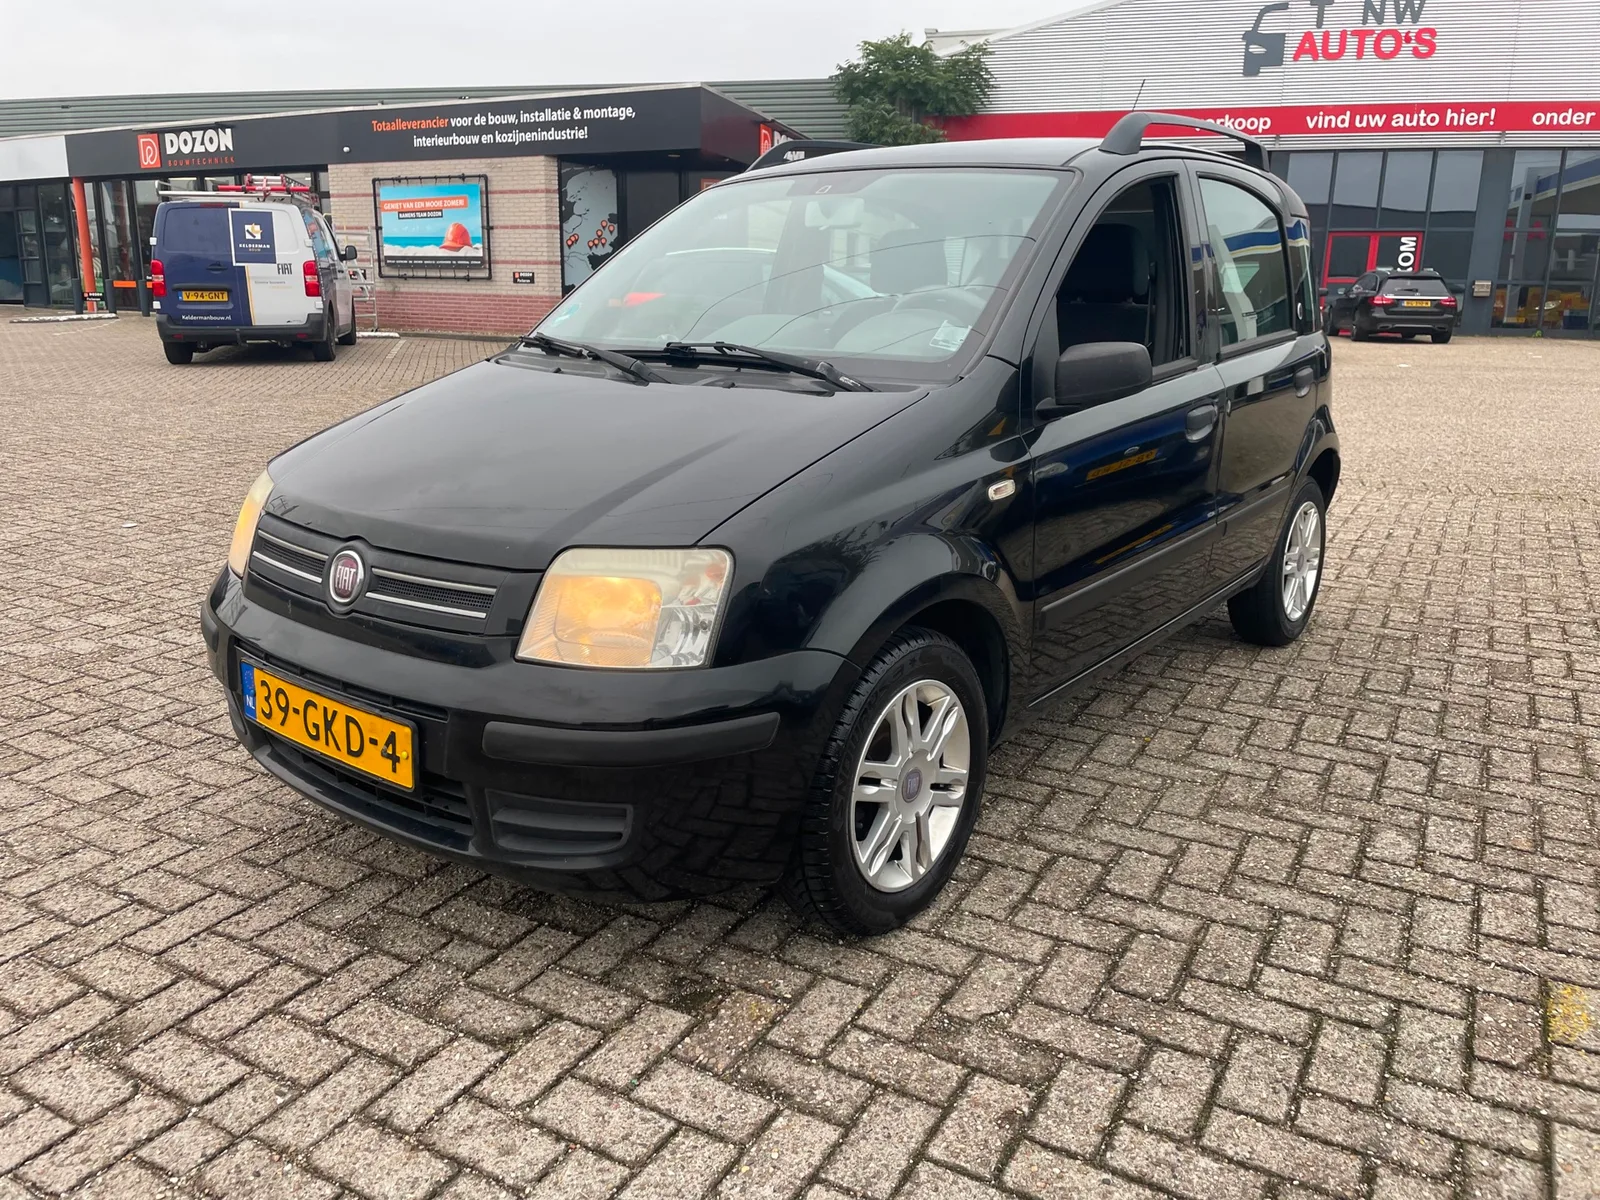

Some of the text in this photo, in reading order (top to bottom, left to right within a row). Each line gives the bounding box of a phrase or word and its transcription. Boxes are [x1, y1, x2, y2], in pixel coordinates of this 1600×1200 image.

[371, 106, 636, 132] Totaalleverancier voor de bouw, installatie & montage,
[1194, 114, 1272, 134] rkoop
[1306, 107, 1496, 129] vind uw auto hier!
[1532, 107, 1596, 126] onder
[164, 128, 234, 155] DOZON
[413, 126, 588, 148] interieurbouw en kozijnenindustrie!
[168, 155, 235, 167] BOUWTECHNIEK
[425, 200, 444, 208] MOOIE
[1396, 236, 1418, 272] OM
[276, 263, 293, 275] FIAT
[184, 292, 226, 300] V-94-GNT
[334, 564, 358, 592] FIAT
[246, 678, 401, 774] NL 39-GKD-4
